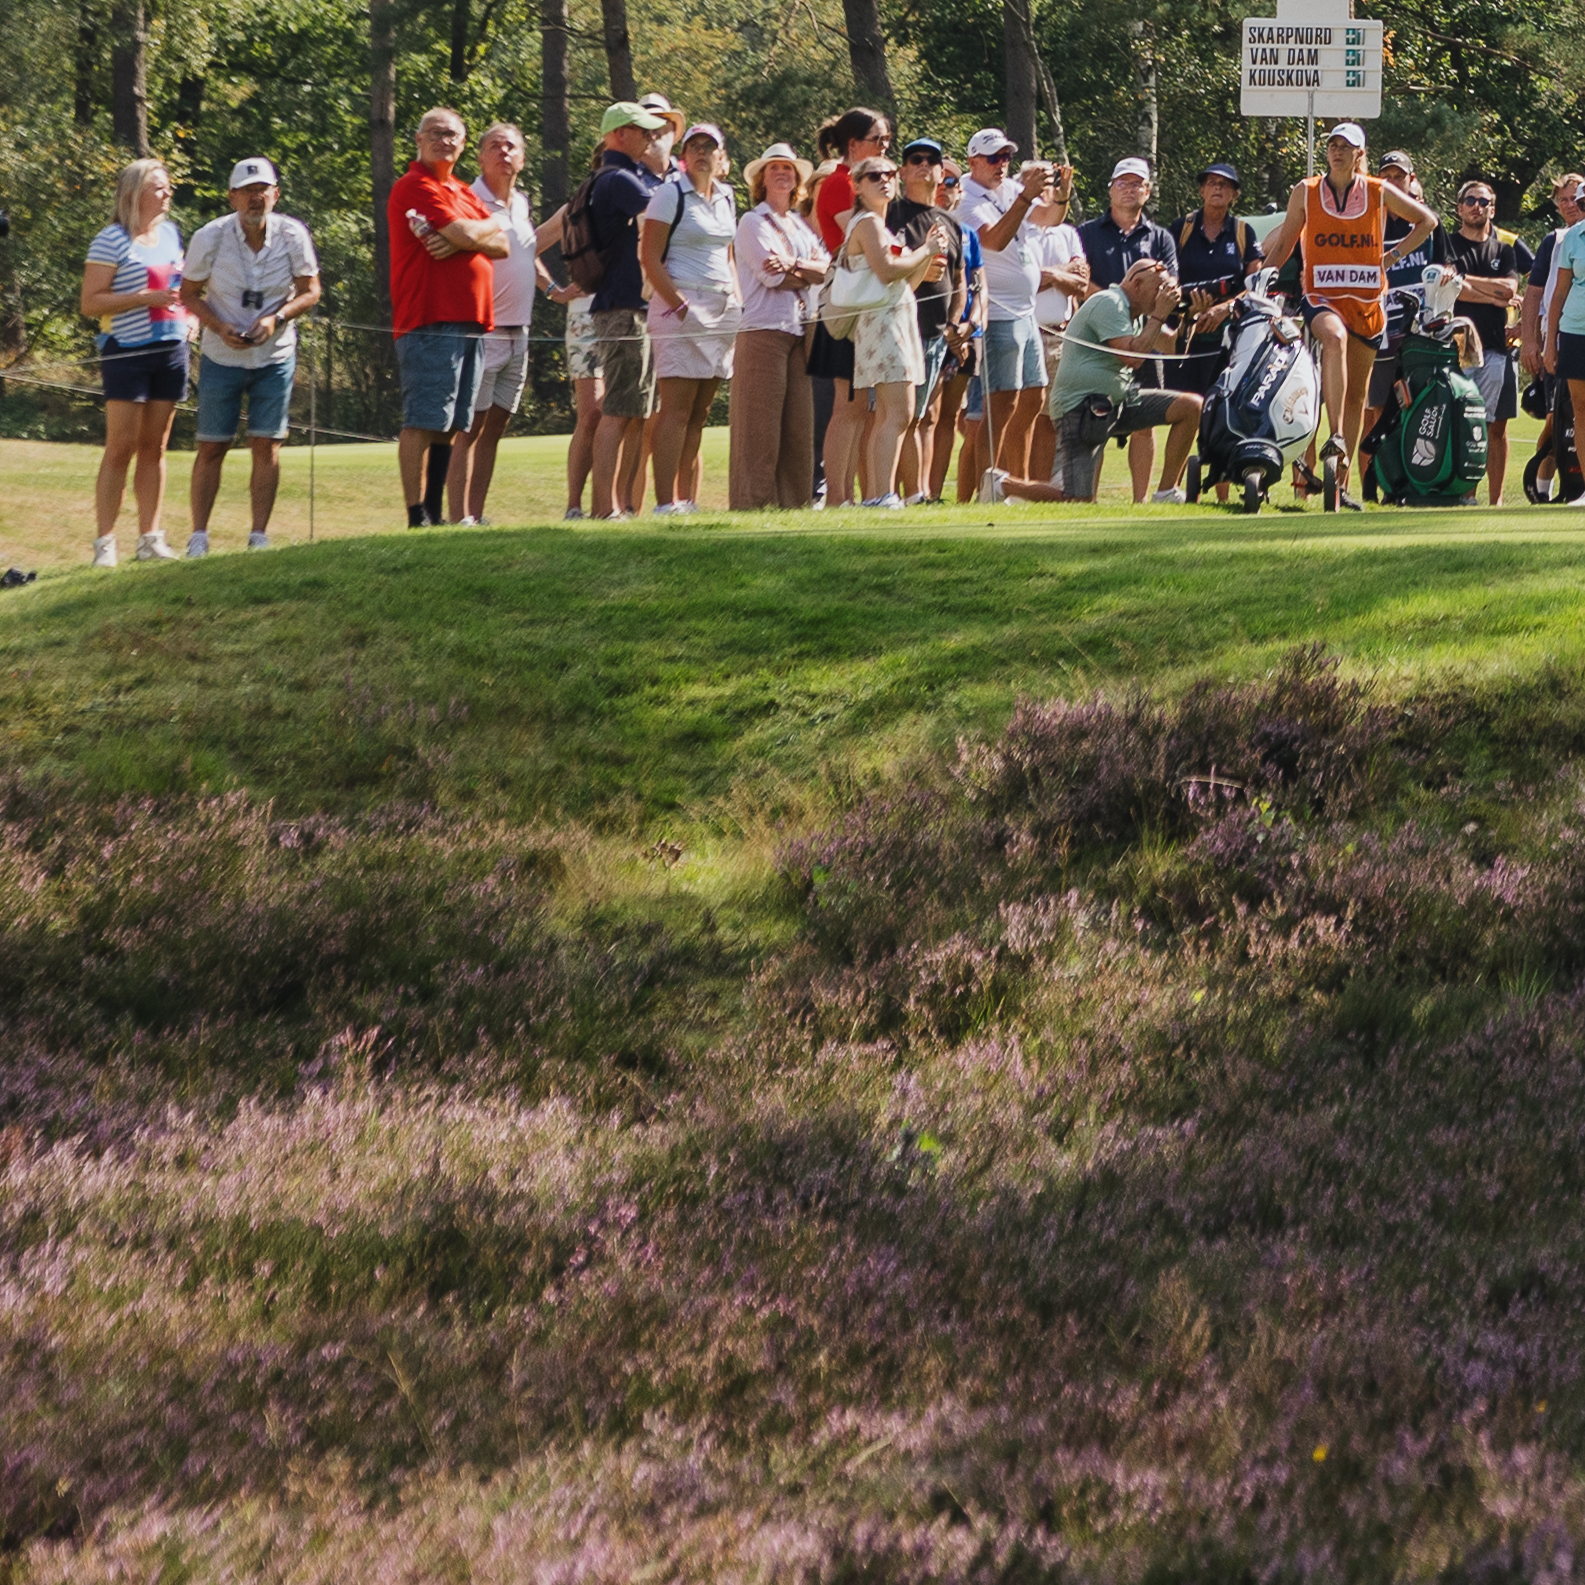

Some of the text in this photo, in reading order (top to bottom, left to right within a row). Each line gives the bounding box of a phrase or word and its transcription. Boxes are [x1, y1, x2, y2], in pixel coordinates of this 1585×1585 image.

[1248, 27, 1332, 46] SKARPNORD
[1250, 48, 1279, 66] VAN
[1287, 48, 1319, 66] DAM
[1249, 69, 1320, 87] KOUSKOVA
[1314, 233, 1378, 248] GOLF.NL
[1317, 270, 1377, 283] VAN DAM
[1418, 407, 1432, 435] GOLF
